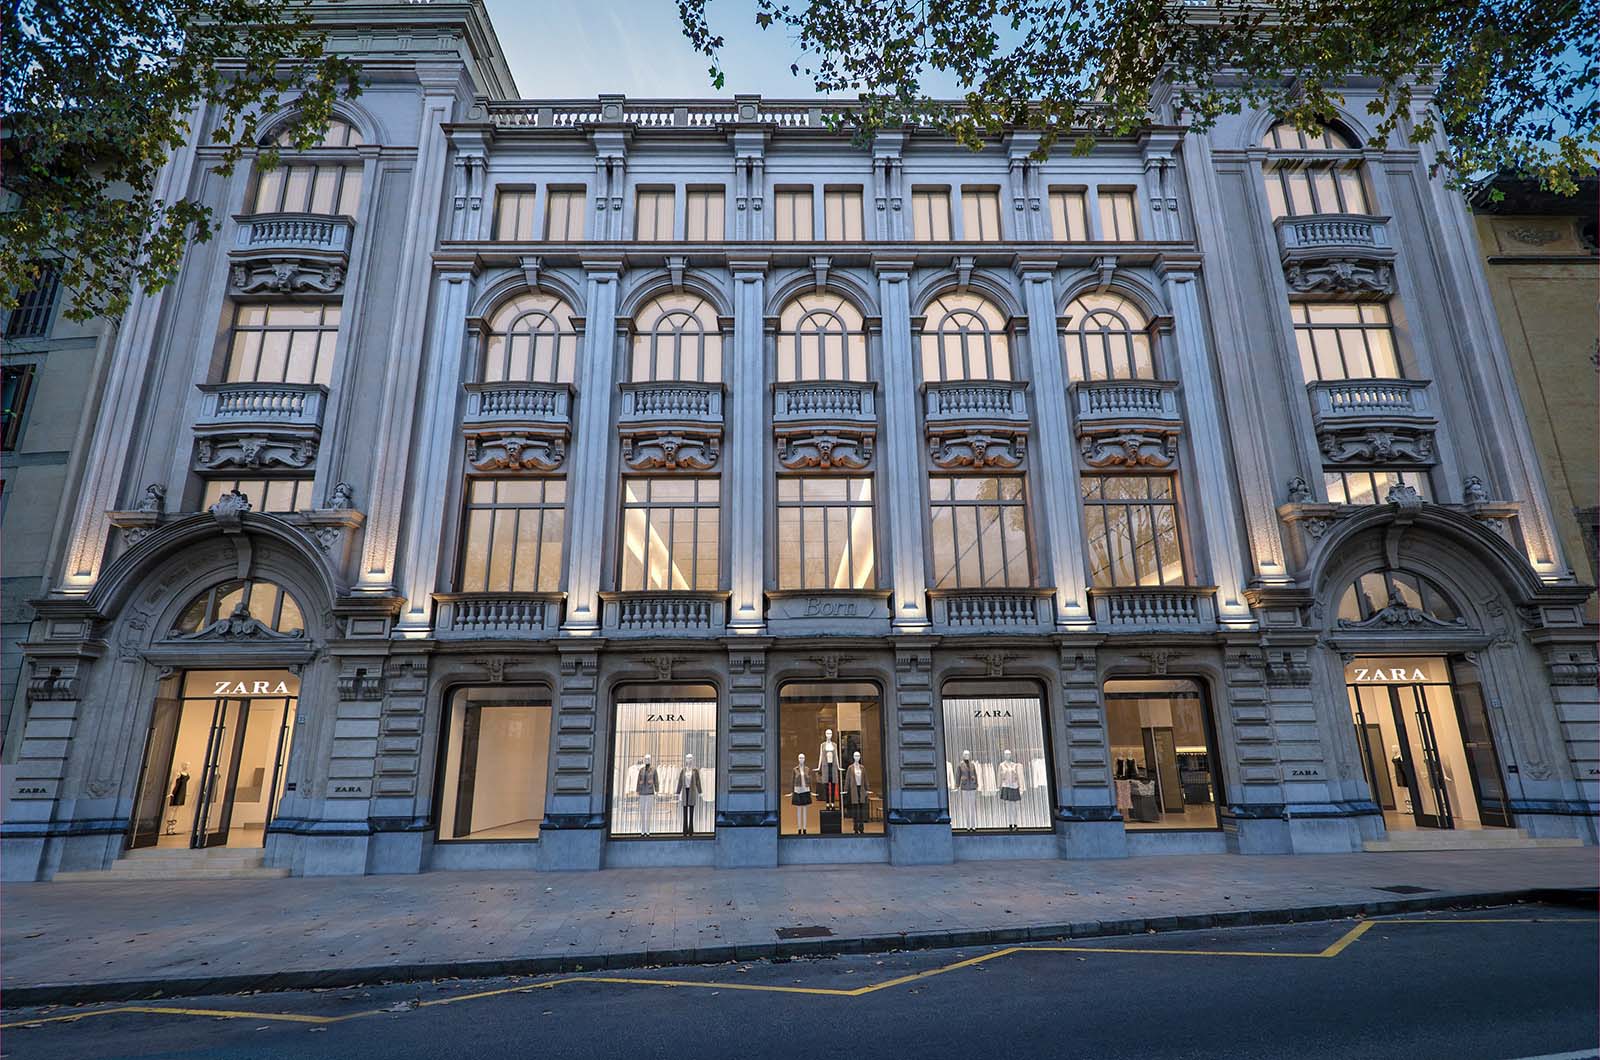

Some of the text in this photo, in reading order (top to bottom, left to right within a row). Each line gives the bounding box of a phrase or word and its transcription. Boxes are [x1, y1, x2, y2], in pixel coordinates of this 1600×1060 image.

[803, 598, 859, 616] Born
[1354, 668, 1429, 681] ZARA
[213, 681, 291, 694] ZARA
[974, 710, 1012, 718] ZARA
